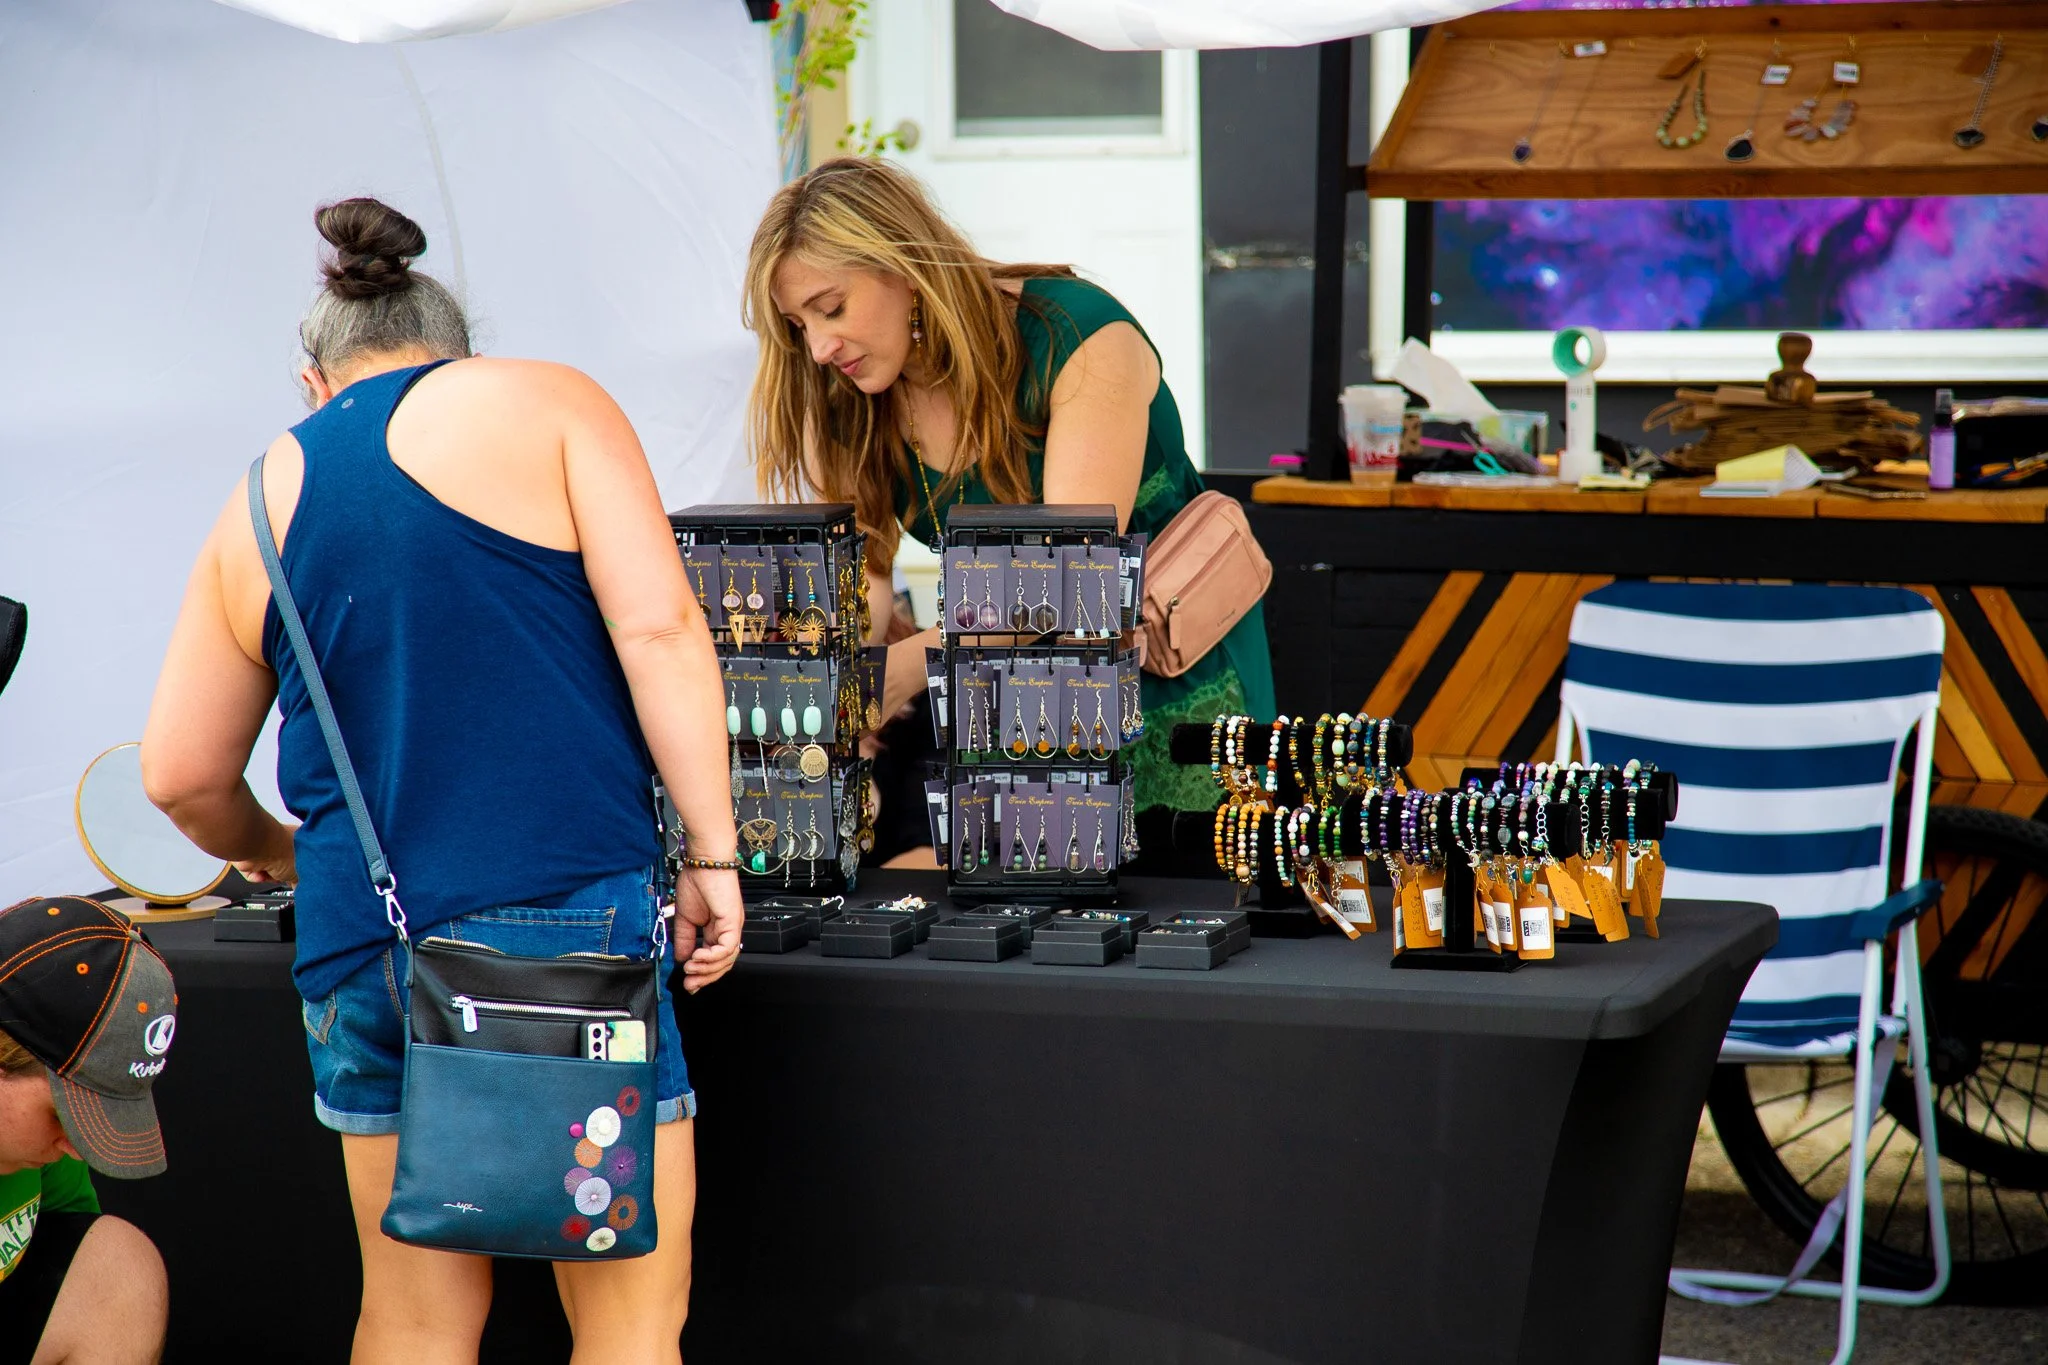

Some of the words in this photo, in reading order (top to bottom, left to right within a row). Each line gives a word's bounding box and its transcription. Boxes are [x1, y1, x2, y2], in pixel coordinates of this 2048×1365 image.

[686, 559, 712, 568] Empress
[721, 558, 739, 567] Twin
[740, 558, 766, 568] Empress
[783, 558, 797, 567] Twin
[798, 559, 819, 568] Empress
[955, 560, 972, 570] Twin
[974, 560, 999, 571] Empress
[1010, 559, 1029, 569] Twin
[1030, 559, 1057, 570] Empress
[1068, 560, 1087, 570] Twin
[1088, 560, 1114, 571] Empress
[723, 672, 741, 681] Twin
[743, 672, 768, 682] Empress
[780, 674, 797, 684] Twin
[798, 674, 822, 684] Empress
[1008, 677, 1026, 686] Twin
[1028, 677, 1054, 688] Empress
[1066, 678, 1084, 688] Twin
[1085, 679, 1111, 689] Empress
[780, 790, 798, 800] Twin
[799, 789, 825, 800] Empress
[1008, 795, 1027, 805] Twin
[1028, 795, 1054, 806] Empress
[1065, 796, 1084, 806] Twin
[1085, 797, 1112, 808] Empress
